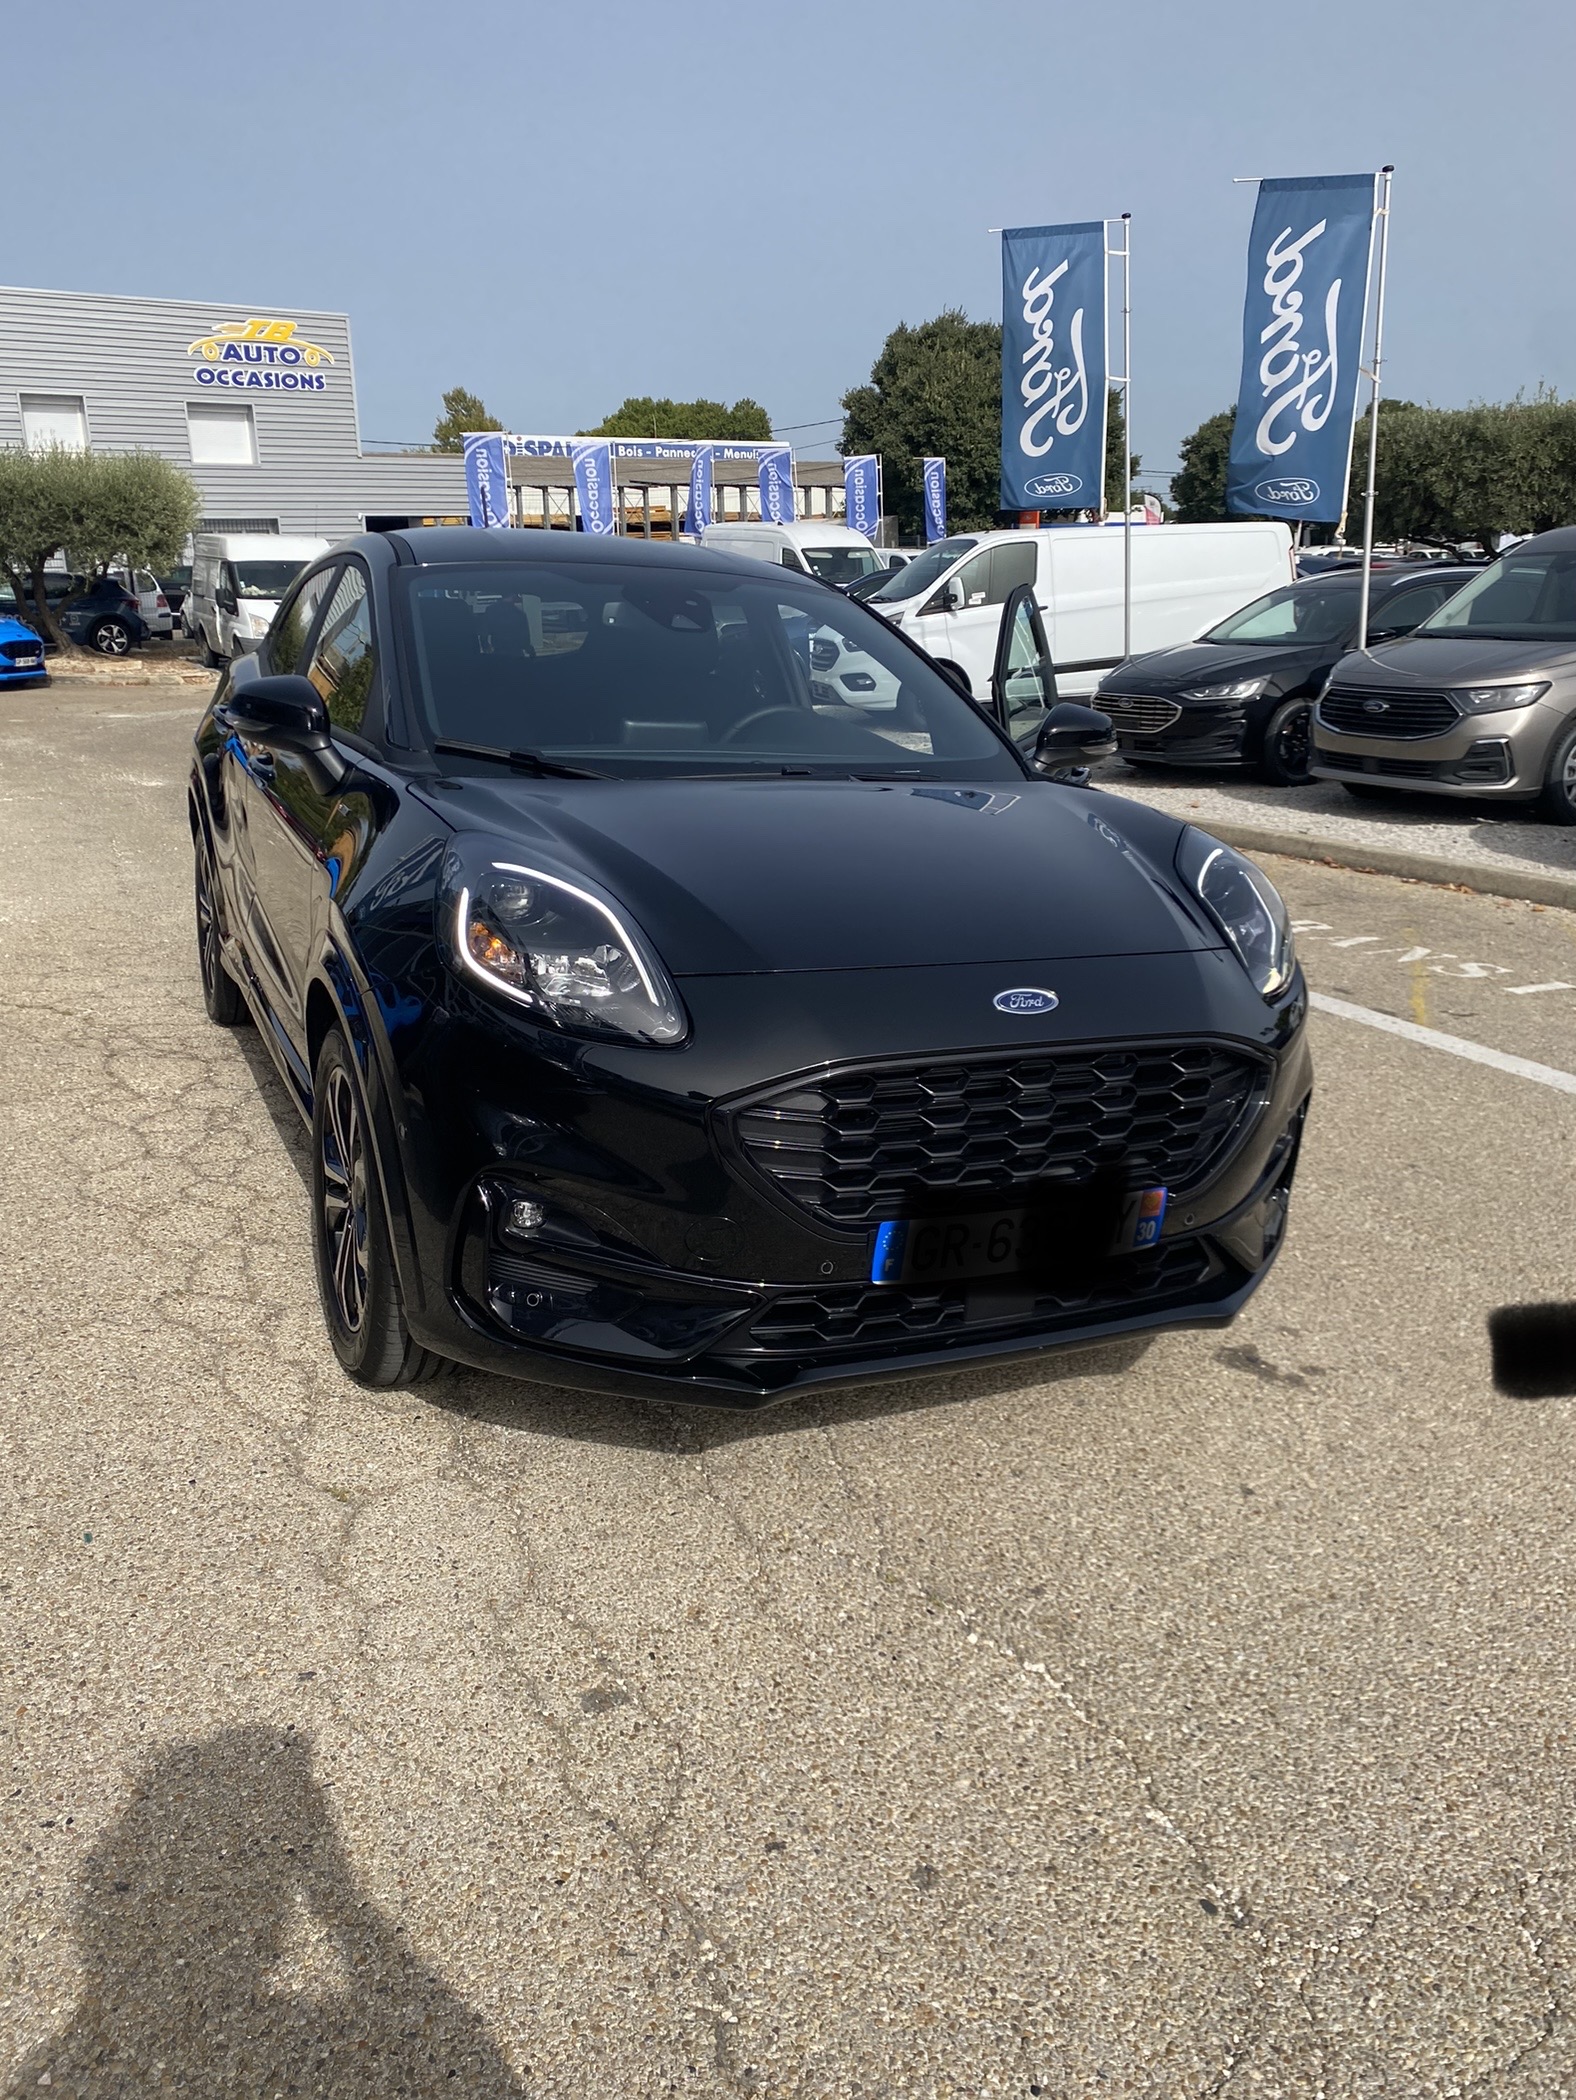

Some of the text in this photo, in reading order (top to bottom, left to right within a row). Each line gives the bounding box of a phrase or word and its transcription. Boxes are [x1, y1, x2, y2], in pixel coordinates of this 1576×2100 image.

[244, 319, 296, 341] TB
[222, 343, 301, 365] AUTO
[196, 367, 325, 390] OCCASIONS
[618, 445, 644, 457] Bois
[655, 446, 697, 458] Pannea
[1009, 993, 1045, 1009] Ford
[1137, 1220, 1156, 1241] 30
